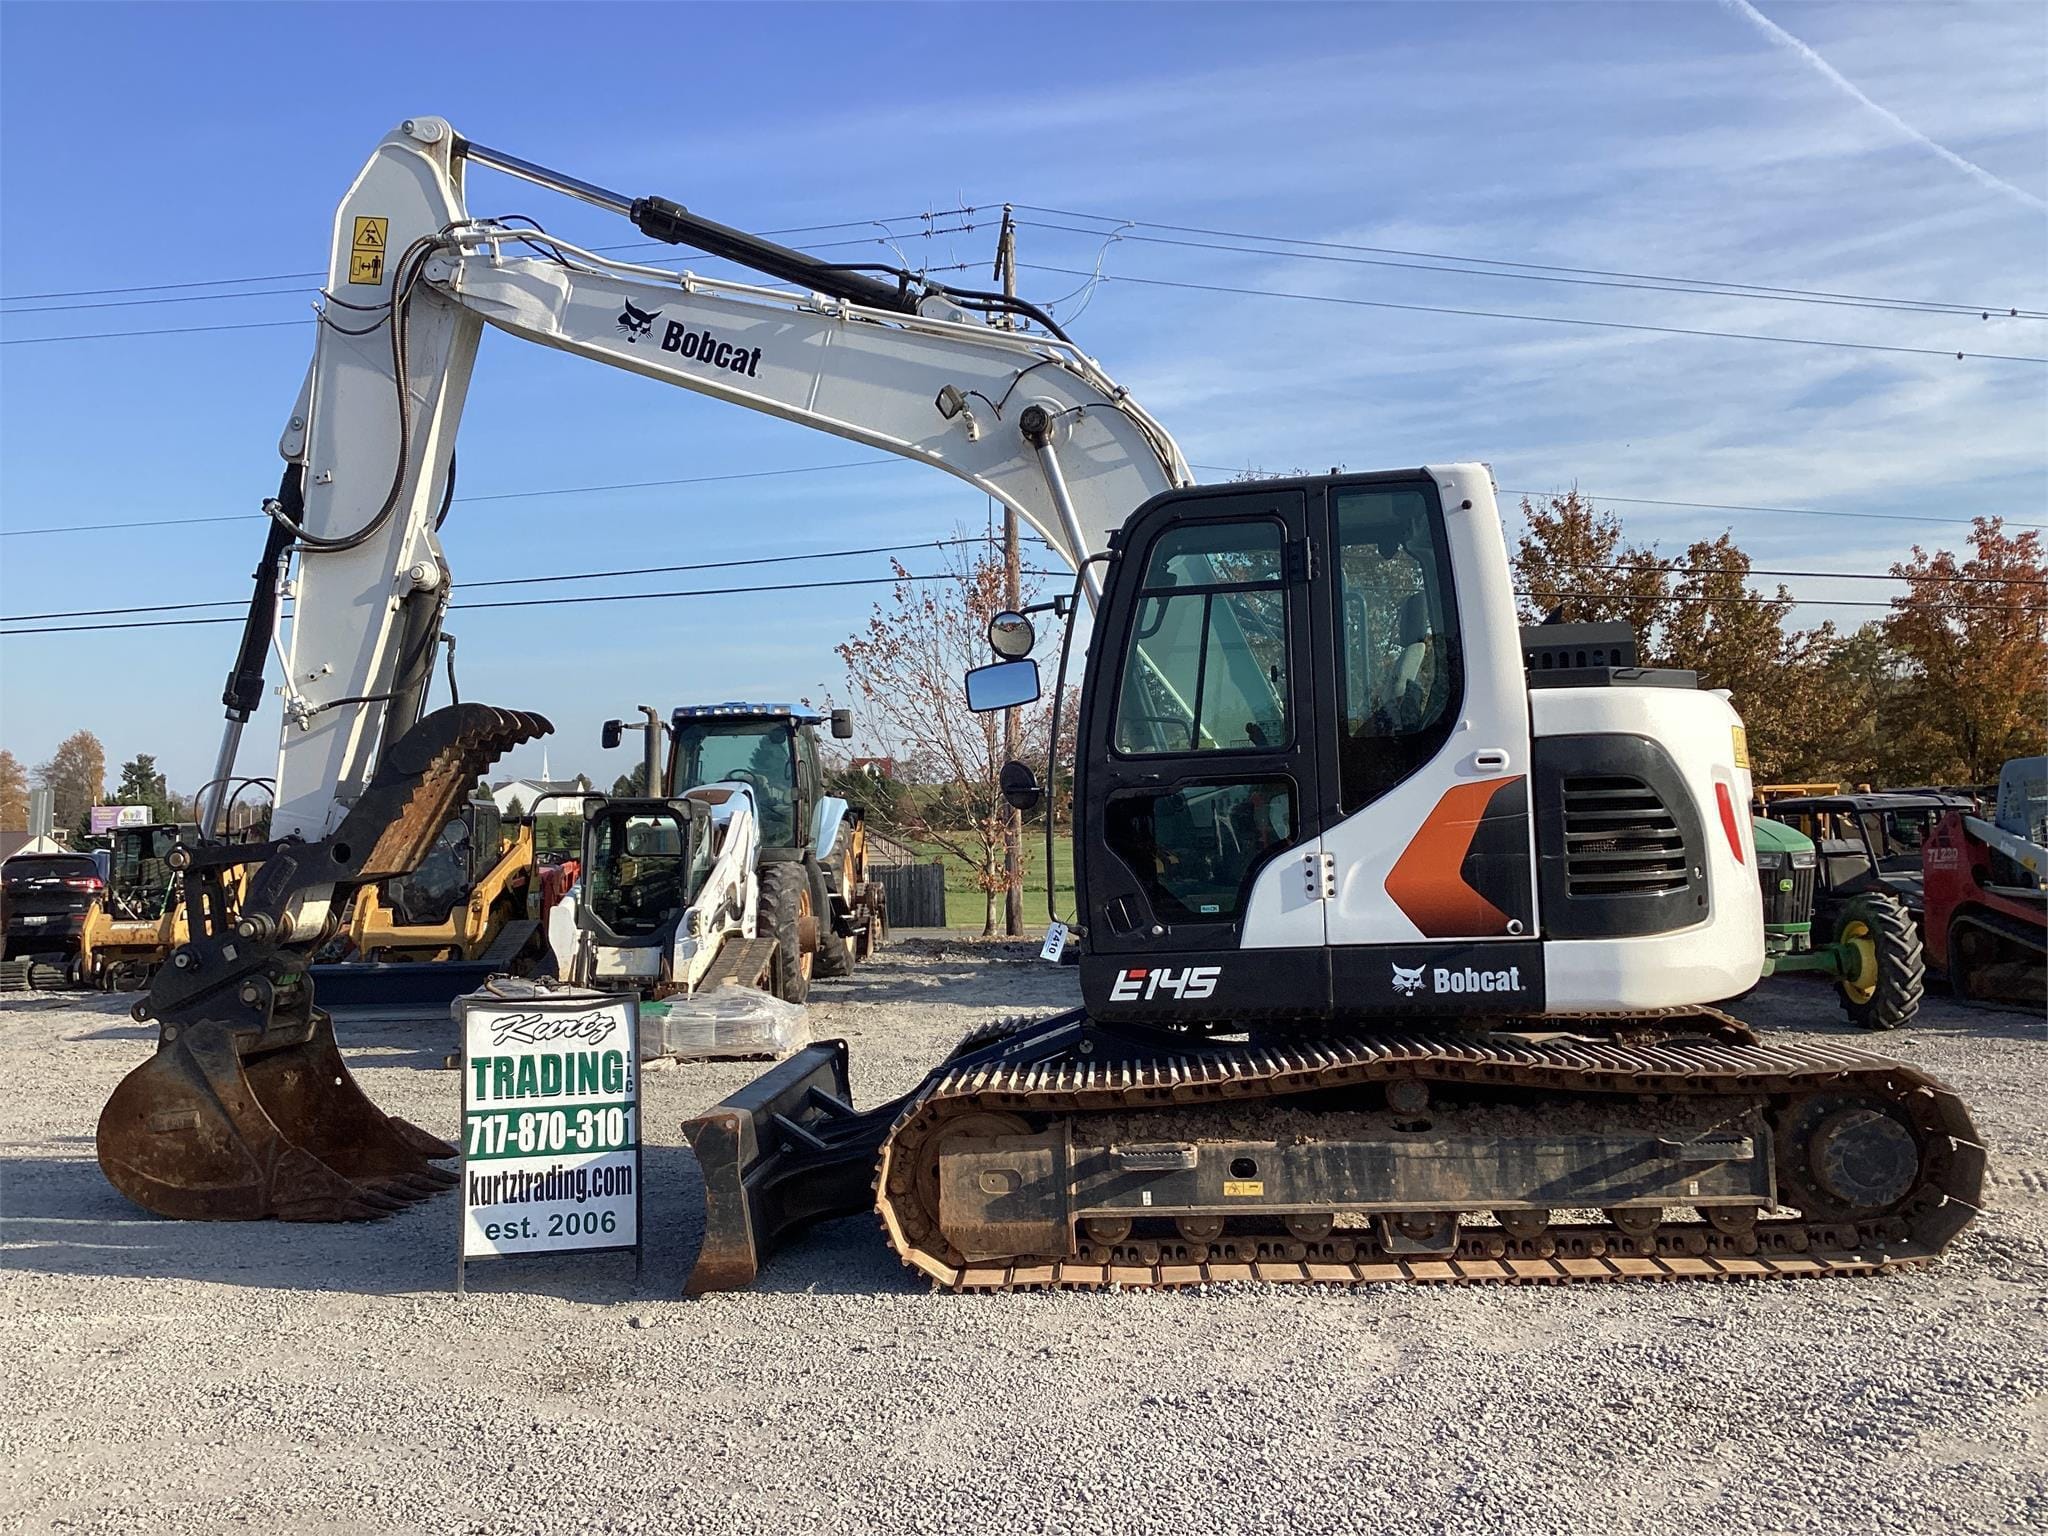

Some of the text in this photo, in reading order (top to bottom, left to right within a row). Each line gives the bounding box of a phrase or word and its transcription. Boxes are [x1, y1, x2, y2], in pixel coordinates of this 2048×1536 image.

[661, 320, 762, 378] Bobcat
[1048, 929, 1063, 954] 7410
[1109, 966, 1221, 1001] E145
[1433, 966, 1520, 993] Bobcat
[490, 1011, 616, 1046] Kurtz
[471, 1049, 623, 1101] TRADING
[467, 1106, 636, 1155] 717-870-3101
[469, 1164, 632, 1206] kurtztrading.com
[485, 1210, 616, 1240] est. 2006
